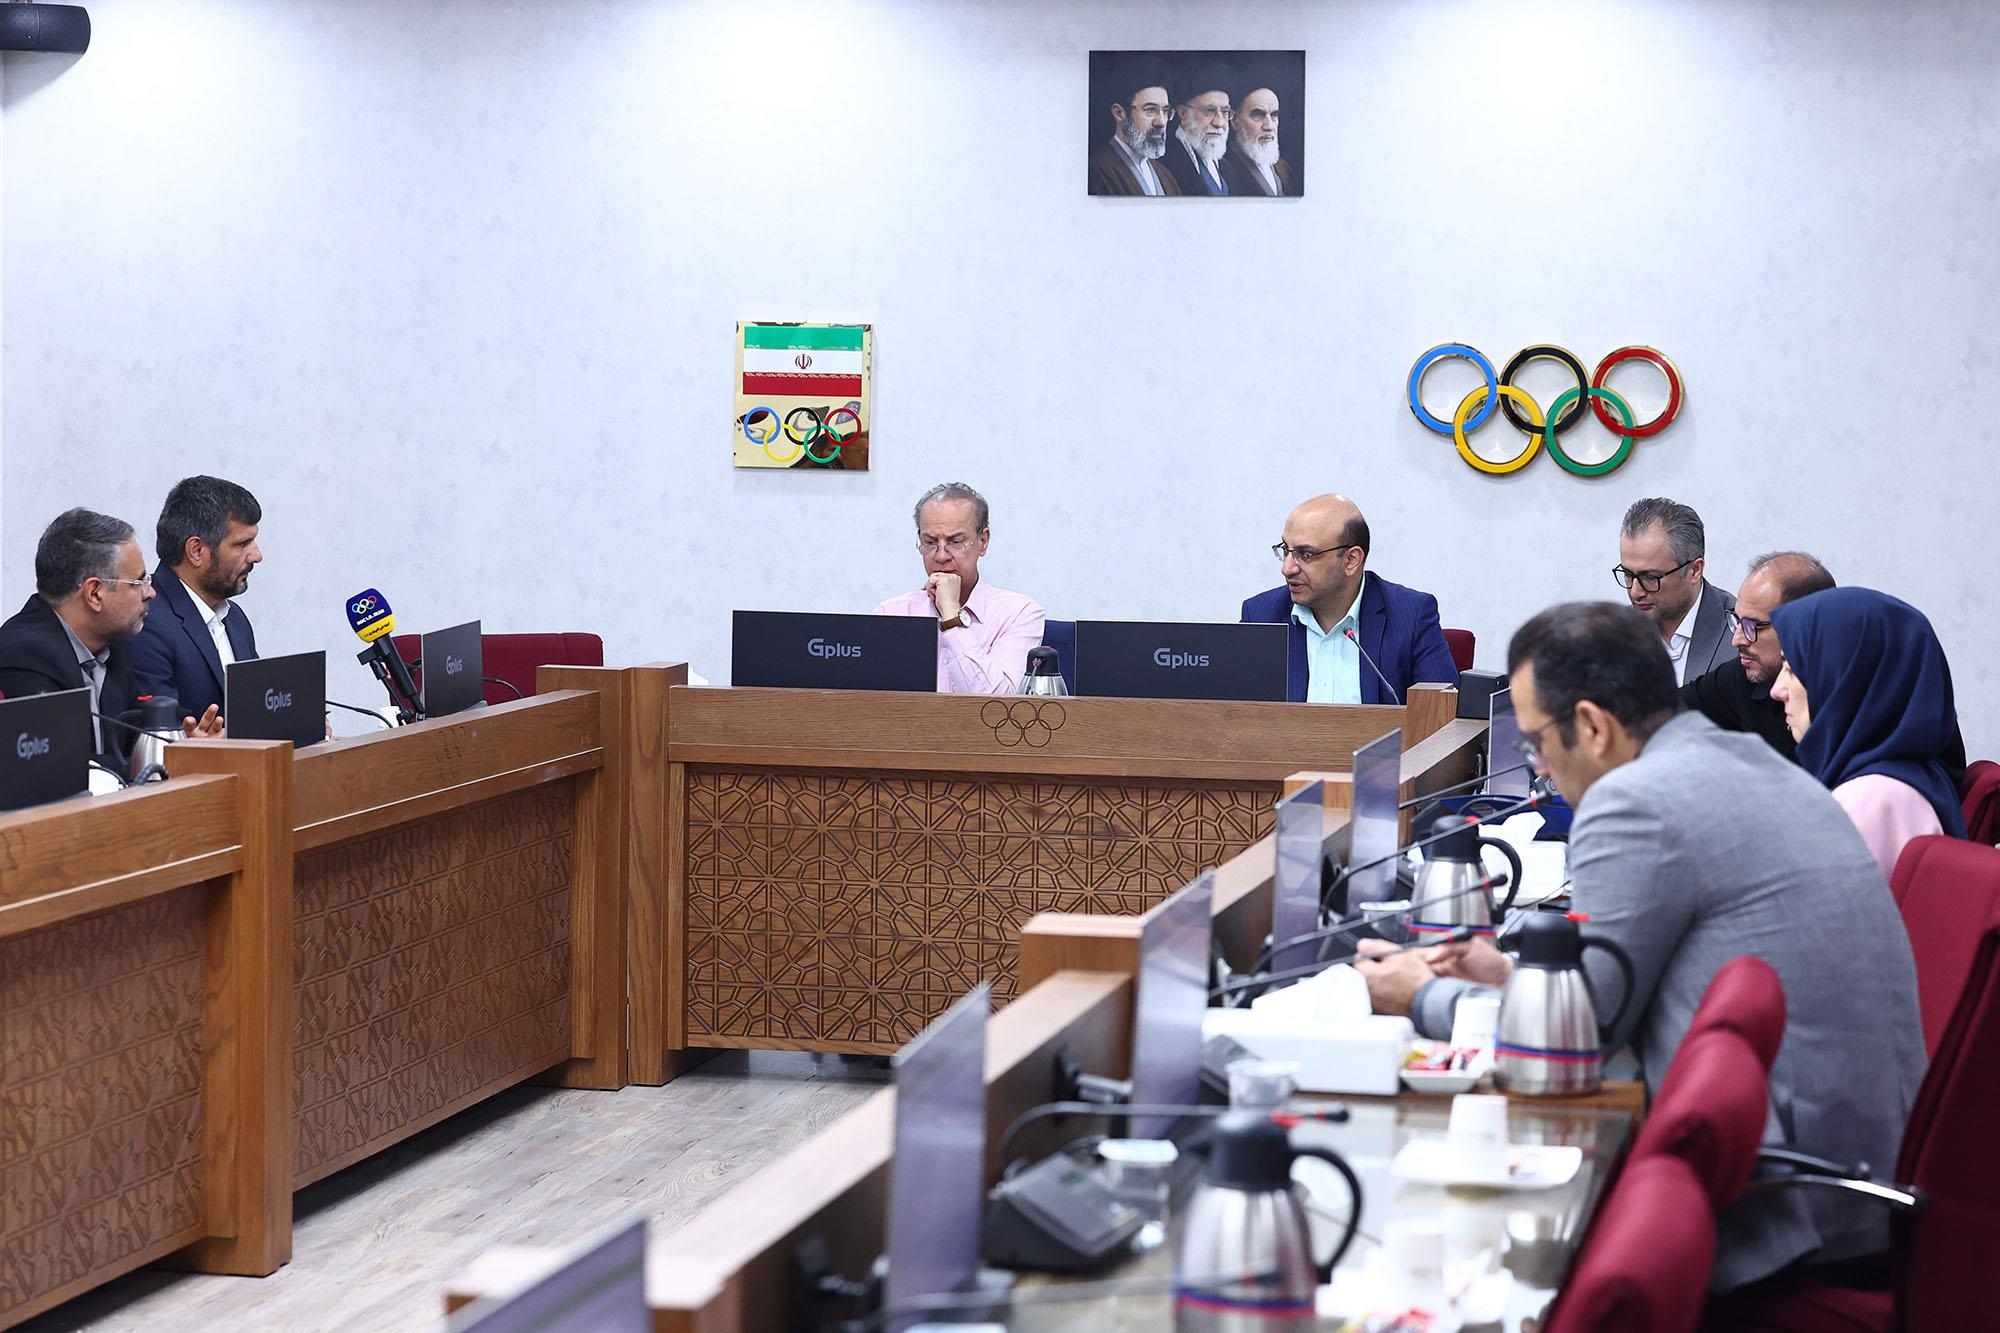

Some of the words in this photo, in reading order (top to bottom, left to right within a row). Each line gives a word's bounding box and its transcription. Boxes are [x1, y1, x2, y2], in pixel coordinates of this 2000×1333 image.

[807, 638, 862, 660] Gplus
[1153, 647, 1210, 669] Gplus
[446, 655, 463, 676] Gplus
[265, 688, 292, 712] Gplus
[16, 732, 50, 760] Gplus
